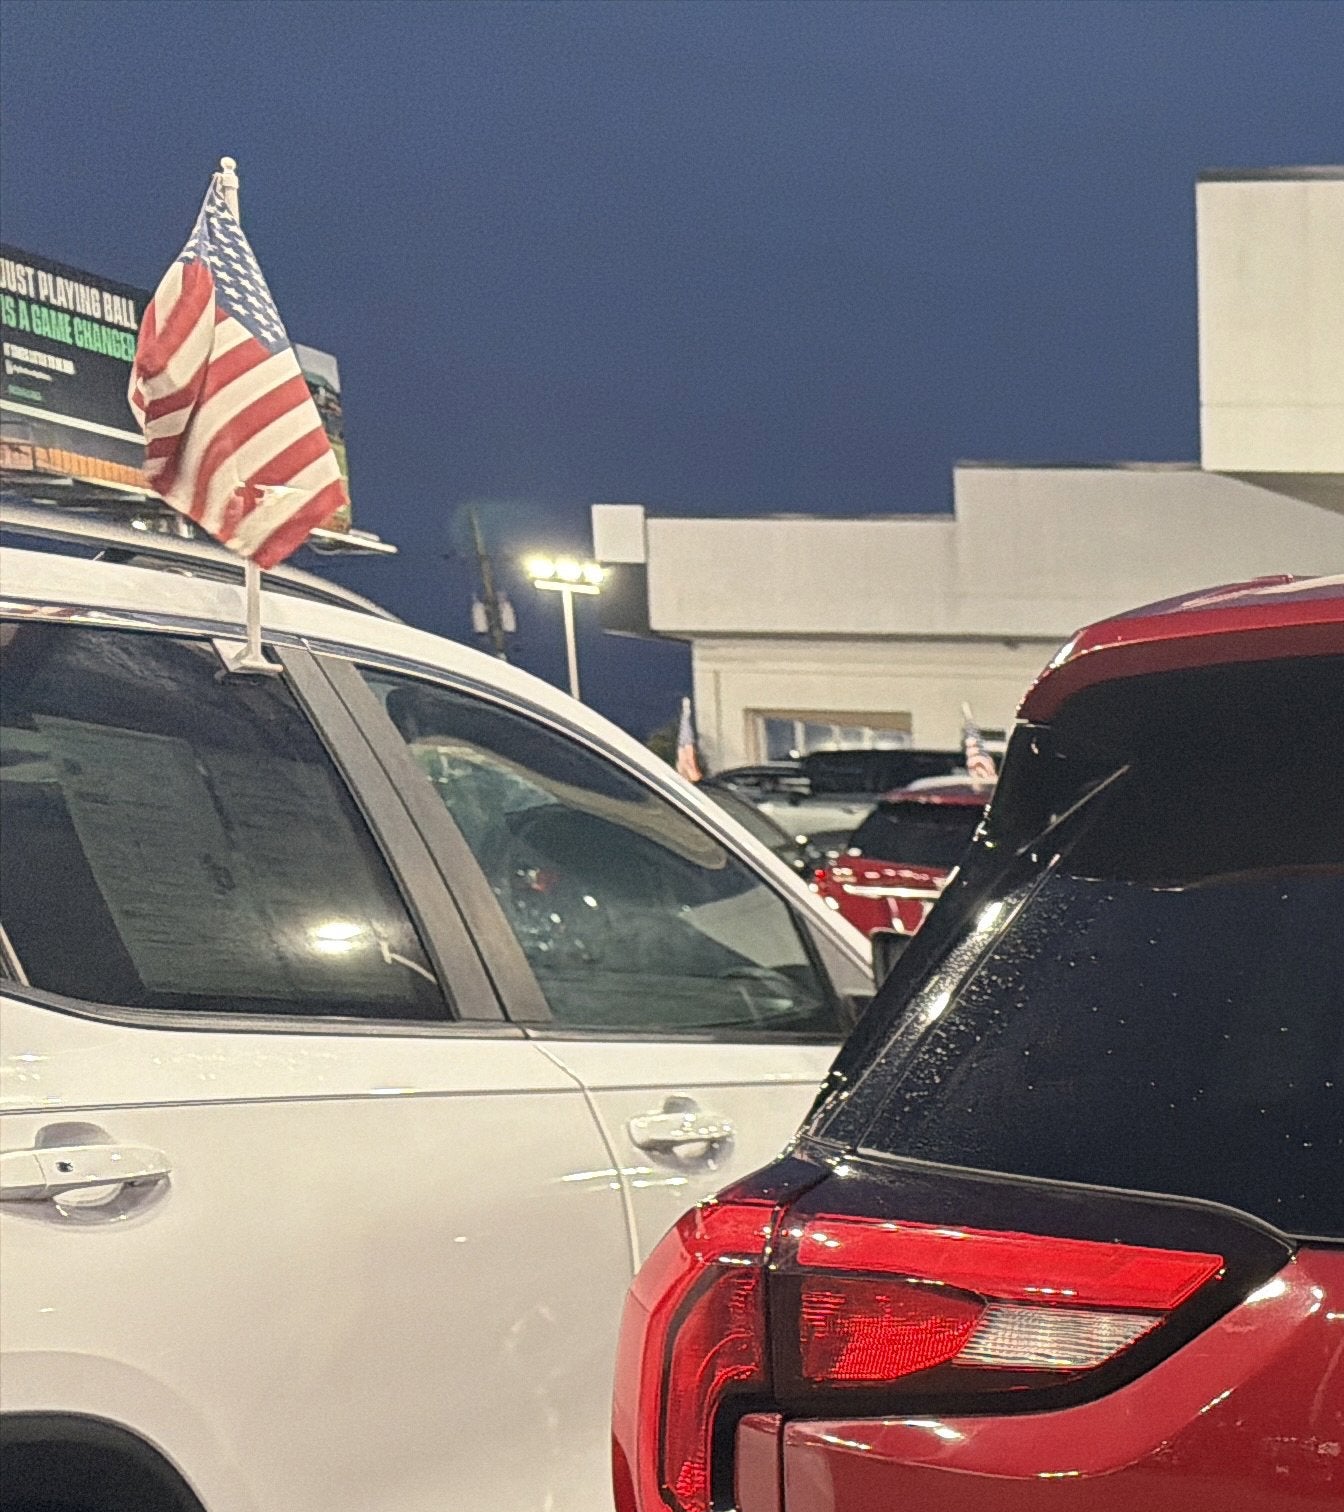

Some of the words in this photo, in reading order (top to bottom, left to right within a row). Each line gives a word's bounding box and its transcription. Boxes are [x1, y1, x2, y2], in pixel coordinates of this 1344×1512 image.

[0, 258, 35, 298] JUST
[37, 270, 102, 319] PLAYING
[102, 291, 139, 330] BALL
[0, 293, 17, 328] IS
[18, 299, 31, 332] A
[30, 303, 73, 345] GAME
[73, 316, 136, 362] CHANGER
